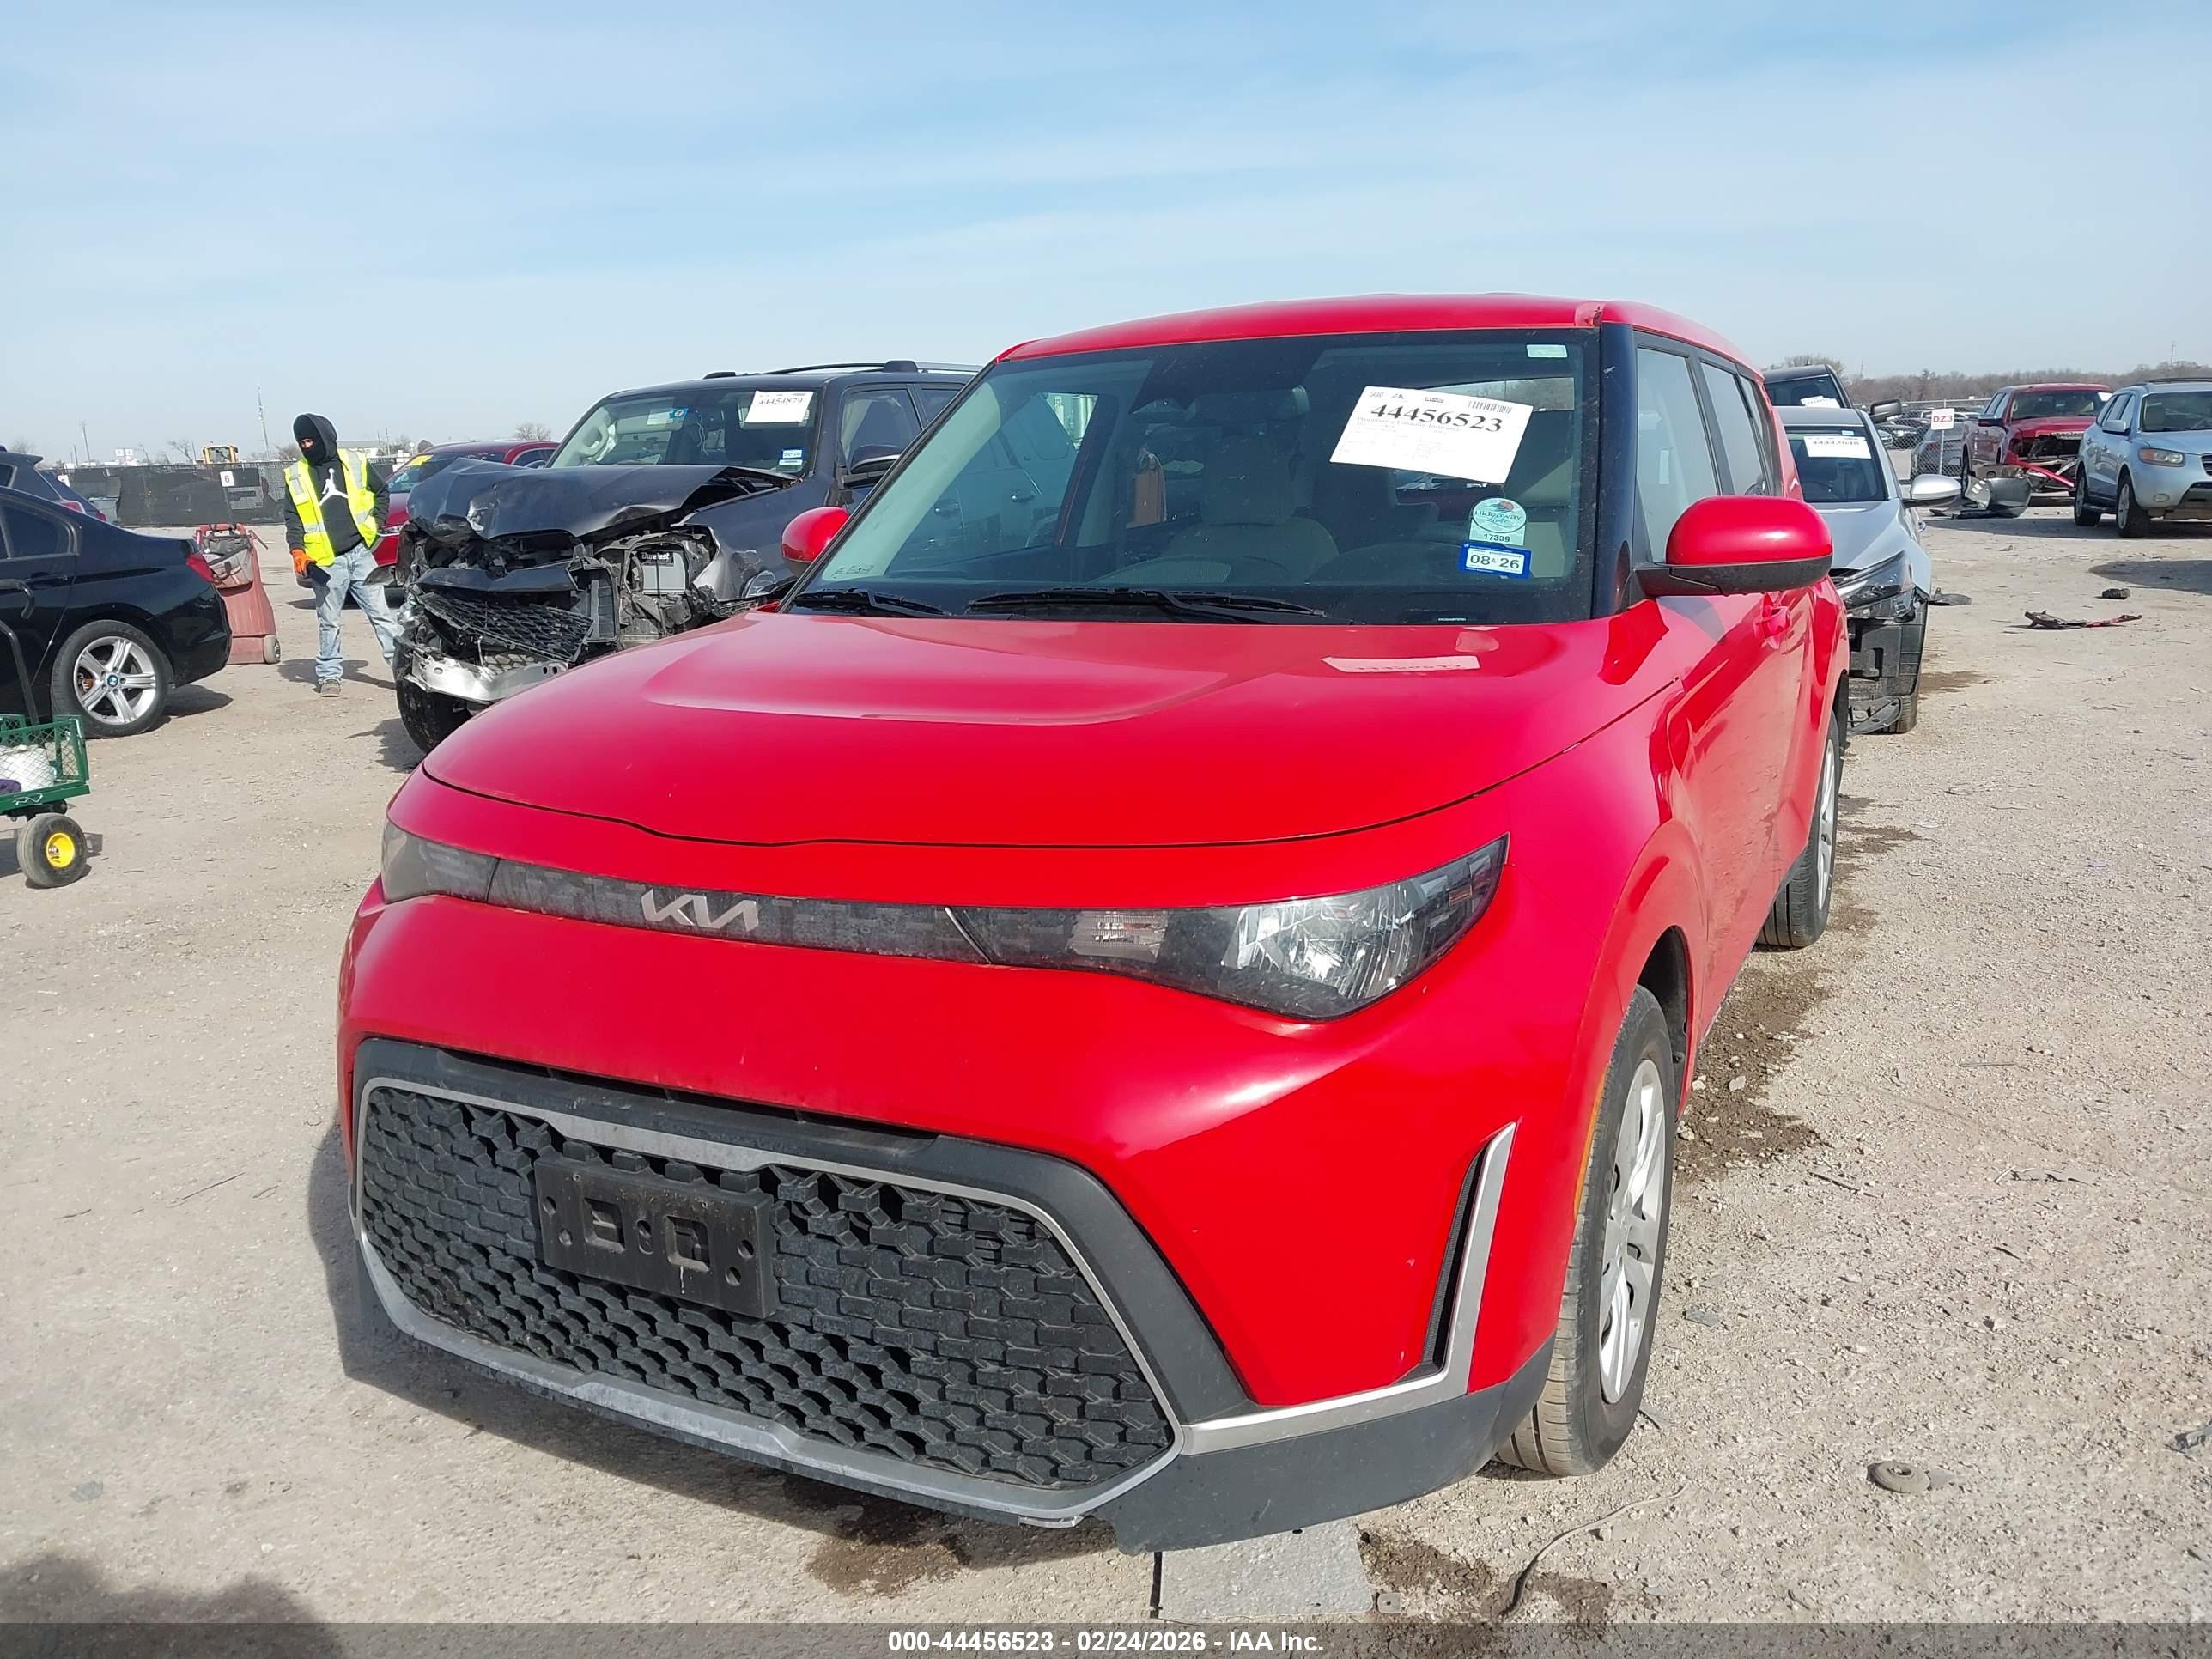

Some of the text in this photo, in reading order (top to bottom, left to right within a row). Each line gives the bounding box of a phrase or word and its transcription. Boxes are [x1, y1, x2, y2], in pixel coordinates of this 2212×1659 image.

[1371, 404, 1503, 433] 44456523
[1933, 415, 1953, 423] DZ3
[1474, 510, 1522, 520] Hideaway
[1484, 533, 1510, 543] 17339
[1470, 554, 1491, 566] 08
[1498, 557, 1520, 569] 26
[641, 889, 759, 932] KIA
